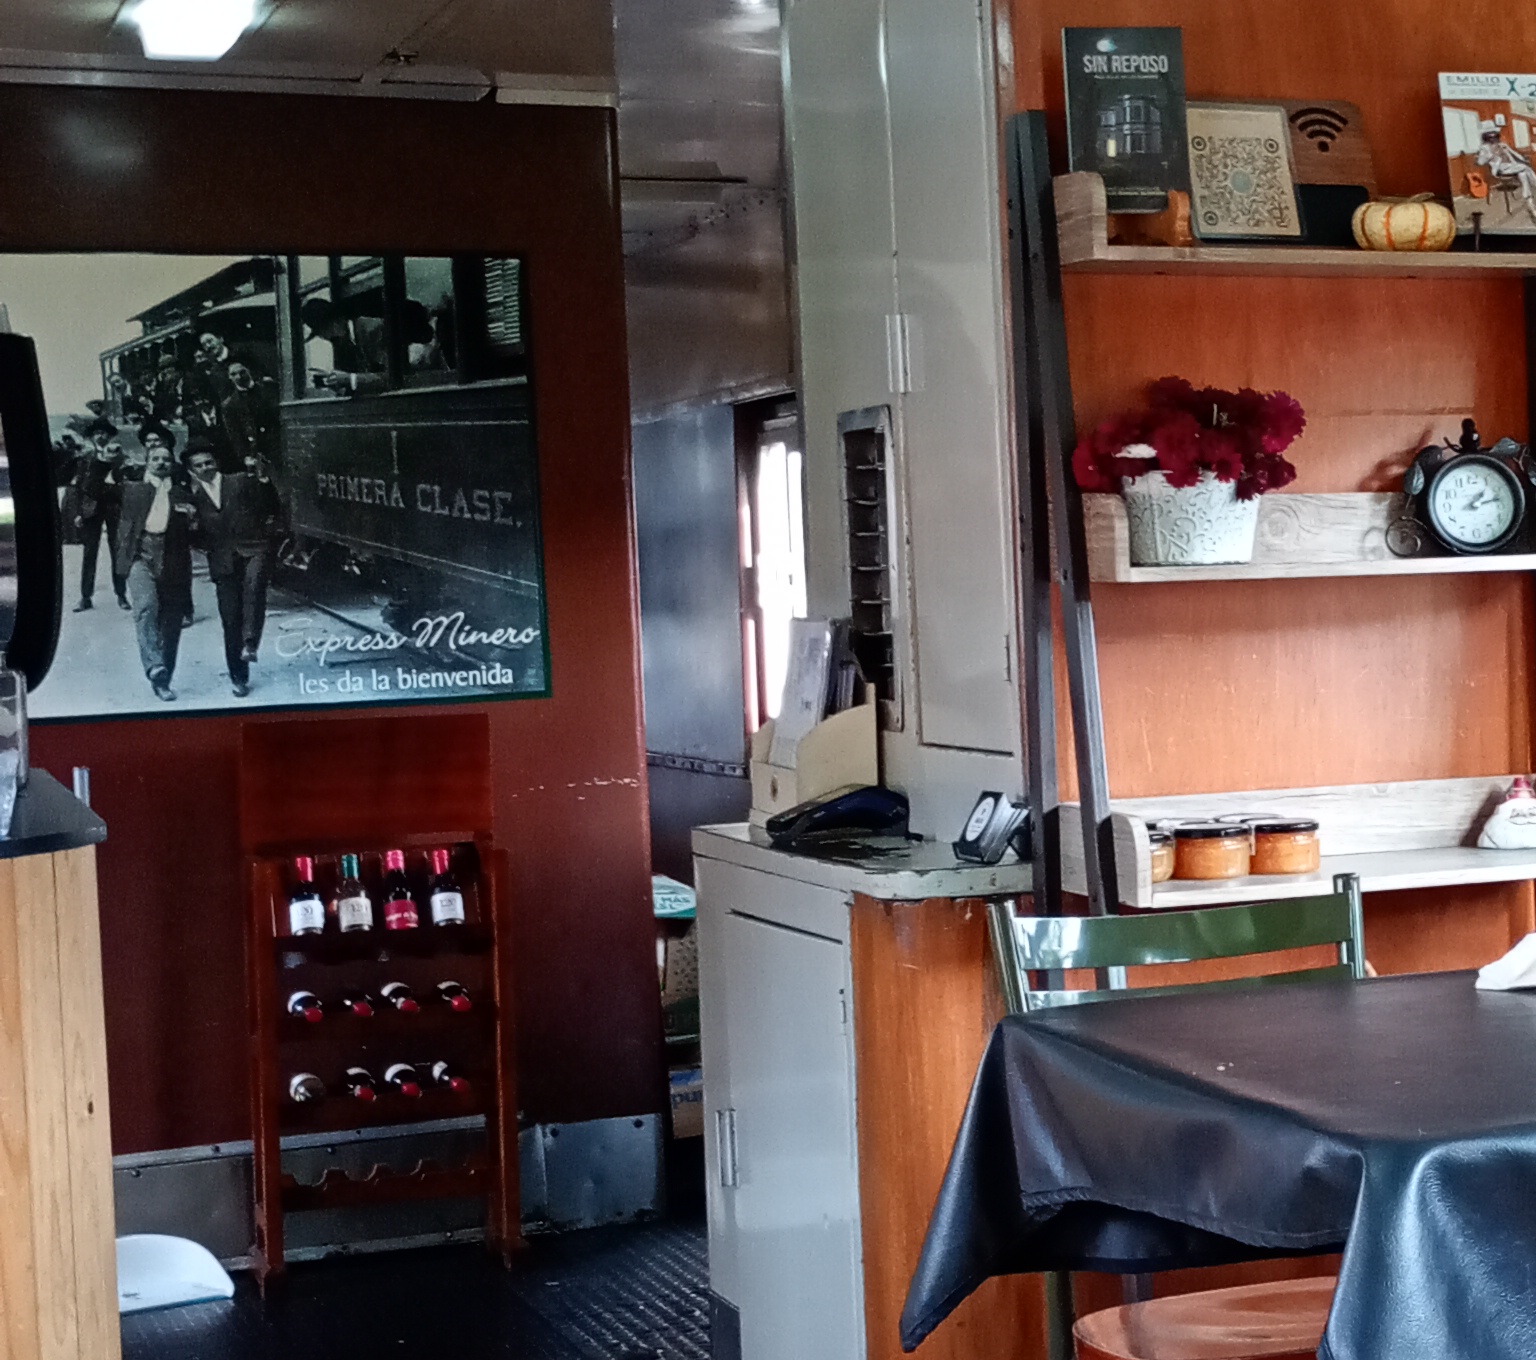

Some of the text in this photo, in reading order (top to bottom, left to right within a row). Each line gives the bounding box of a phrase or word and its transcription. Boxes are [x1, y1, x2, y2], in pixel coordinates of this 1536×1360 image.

[1082, 54, 1169, 73] SIN REPOSO
[317, 472, 405, 509] PRIMERA
[275, 611, 541, 667] Express Minero
[299, 662, 514, 695] les da la bienvenida
